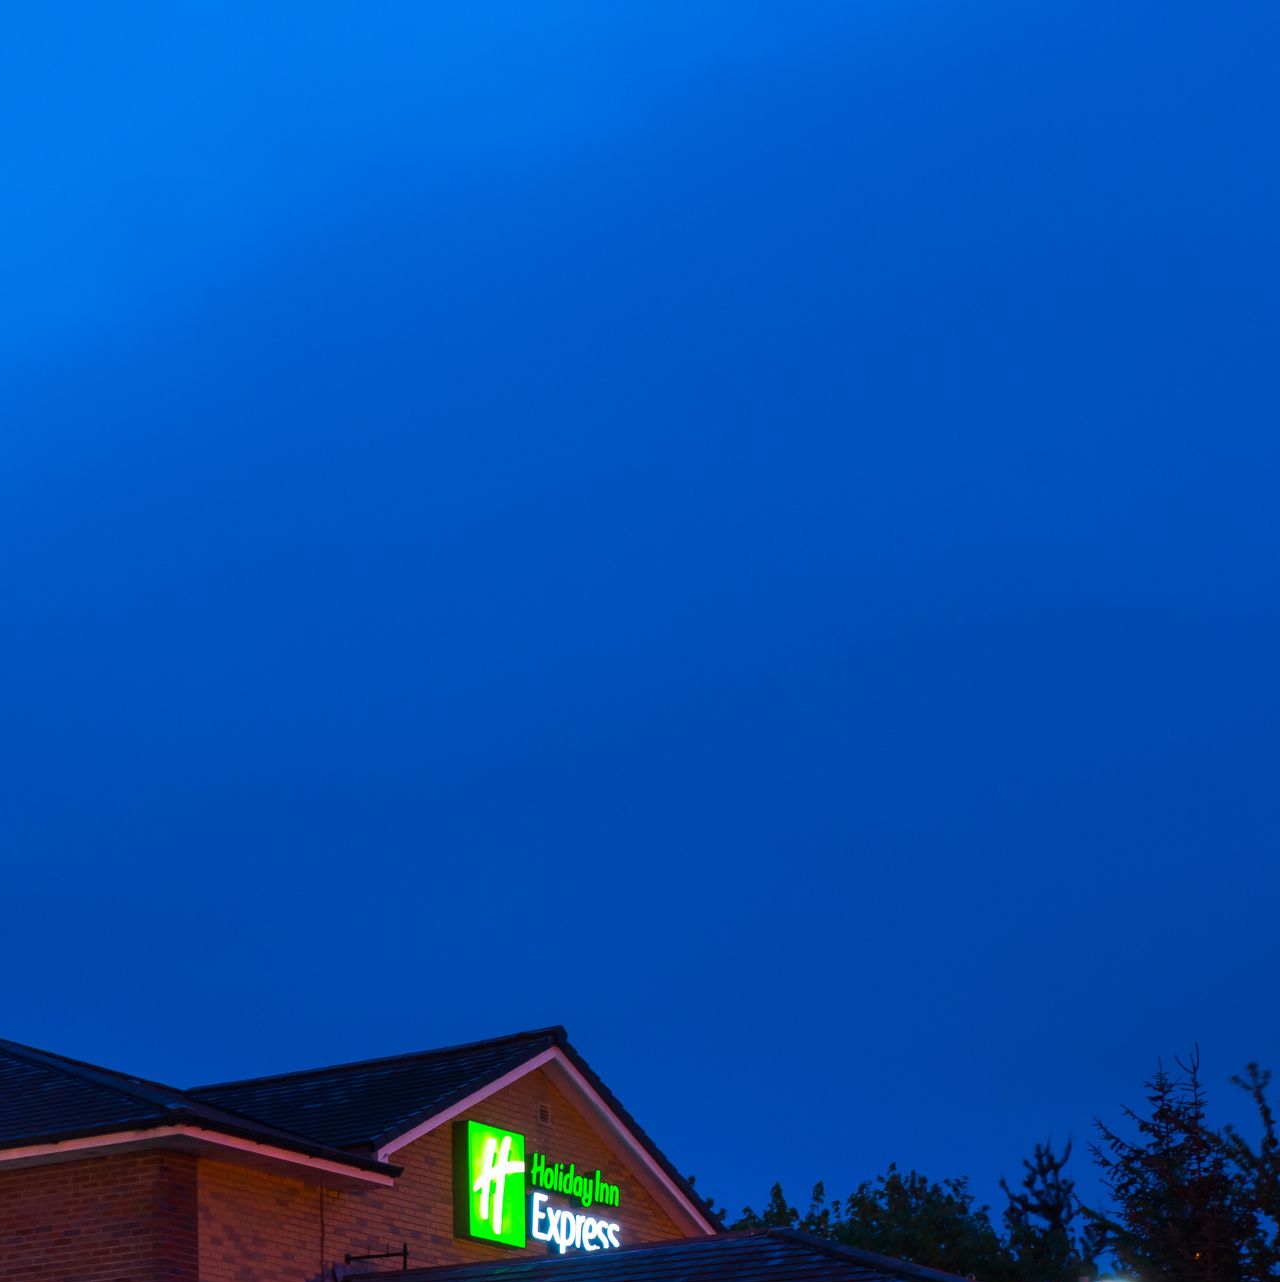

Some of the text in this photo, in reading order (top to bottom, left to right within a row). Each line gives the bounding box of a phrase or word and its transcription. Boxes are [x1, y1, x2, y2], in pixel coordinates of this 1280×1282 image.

[531, 1152, 620, 1207] Holiday Inn
[531, 1192, 620, 1254] Express
